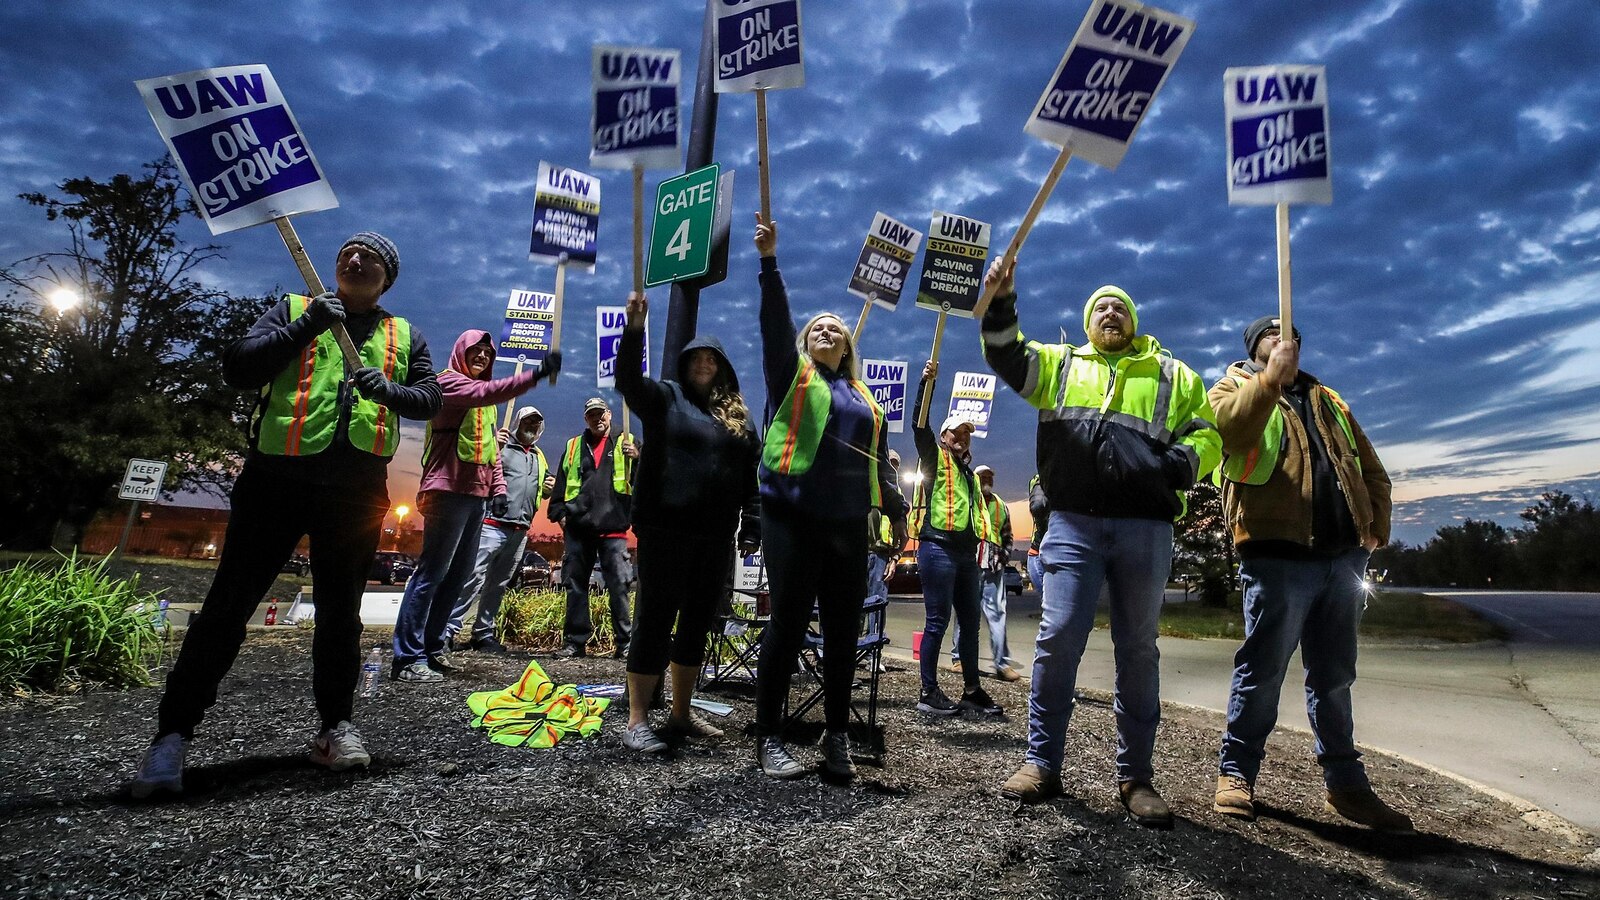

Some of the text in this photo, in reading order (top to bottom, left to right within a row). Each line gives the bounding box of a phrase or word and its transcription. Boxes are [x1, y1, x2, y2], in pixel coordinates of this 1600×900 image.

[740, 8, 770, 41] ON
[1093, 1, 1184, 57] UAW
[720, 24, 798, 78] STRIKE
[601, 53, 674, 81] UAW
[1085, 58, 1134, 89] ON
[154, 73, 267, 120] UAW
[1237, 74, 1317, 105] UAW
[618, 86, 651, 120] ON
[1040, 88, 1150, 122] STRIKE
[211, 117, 261, 162] ON
[595, 106, 677, 152] STRIKE
[1256, 110, 1295, 149] ON
[1231, 131, 1327, 185] STRIKE
[199, 133, 308, 213] STRIKE
[548, 168, 591, 196] UAW
[660, 180, 712, 215] GATE
[545, 208, 588, 228] SAVING
[940, 215, 982, 243] UAW
[665, 219, 692, 261] 4
[879, 218, 914, 248] UAW
[869, 238, 912, 260] STAND UP
[930, 241, 984, 258] STAND UP
[868, 252, 902, 275] END
[933, 258, 974, 273] SAVING
[859, 263, 902, 291] TIERS
[923, 269, 980, 287] AMERICAN
[930, 280, 969, 296] DREAM
[517, 293, 553, 310] UAW
[508, 311, 539, 320] STAND
[512, 322, 546, 331] RECORD
[602, 312, 627, 329] UA
[509, 335, 543, 343] RECORD
[510, 328, 544, 337] PROFITS
[500, 341, 549, 351] CONTRACTS
[867, 364, 904, 381] UAW
[962, 376, 989, 389] UAW
[874, 385, 891, 402] ON
[879, 397, 904, 415] IKE
[956, 399, 985, 412] END
[132, 464, 160, 475] KEEP
[123, 485, 156, 495] RIGHT
